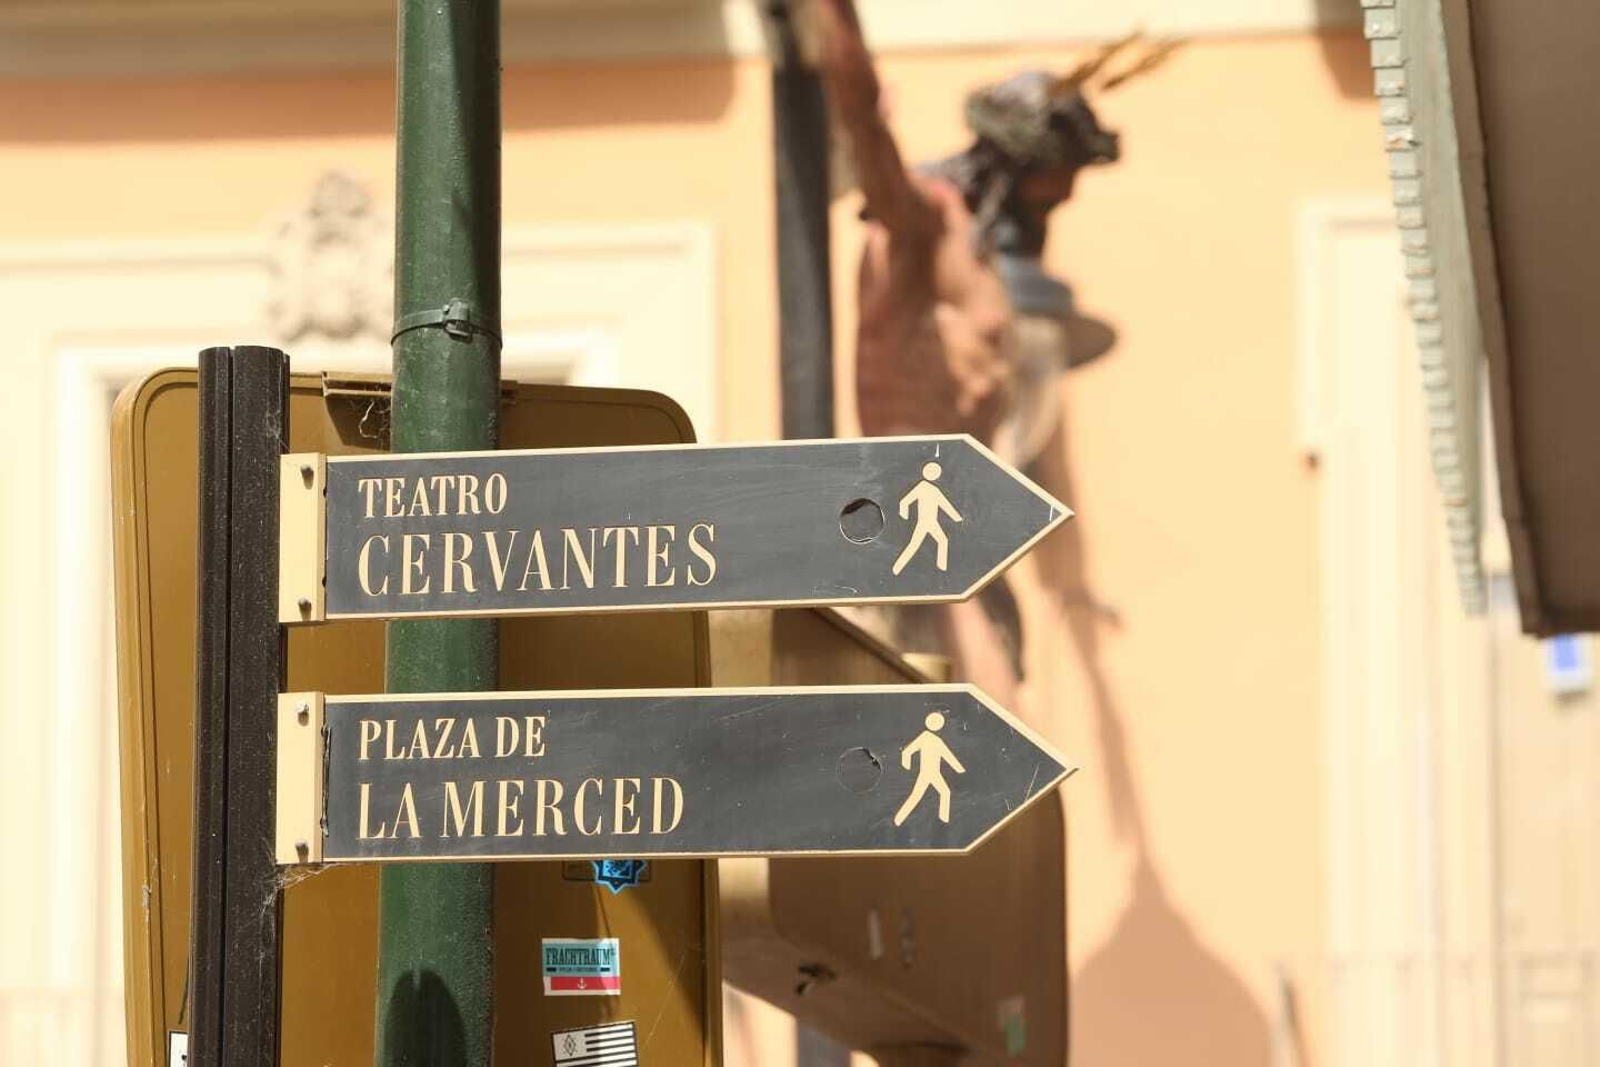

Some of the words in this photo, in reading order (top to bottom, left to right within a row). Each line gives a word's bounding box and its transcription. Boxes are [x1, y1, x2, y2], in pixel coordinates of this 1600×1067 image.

[358, 473, 507, 519] TEATRO
[358, 523, 717, 597] CERVANTES
[358, 718, 482, 760] PLAZA
[494, 716, 547, 757] DE
[356, 781, 424, 840] LA
[439, 777, 685, 838] MERCED
